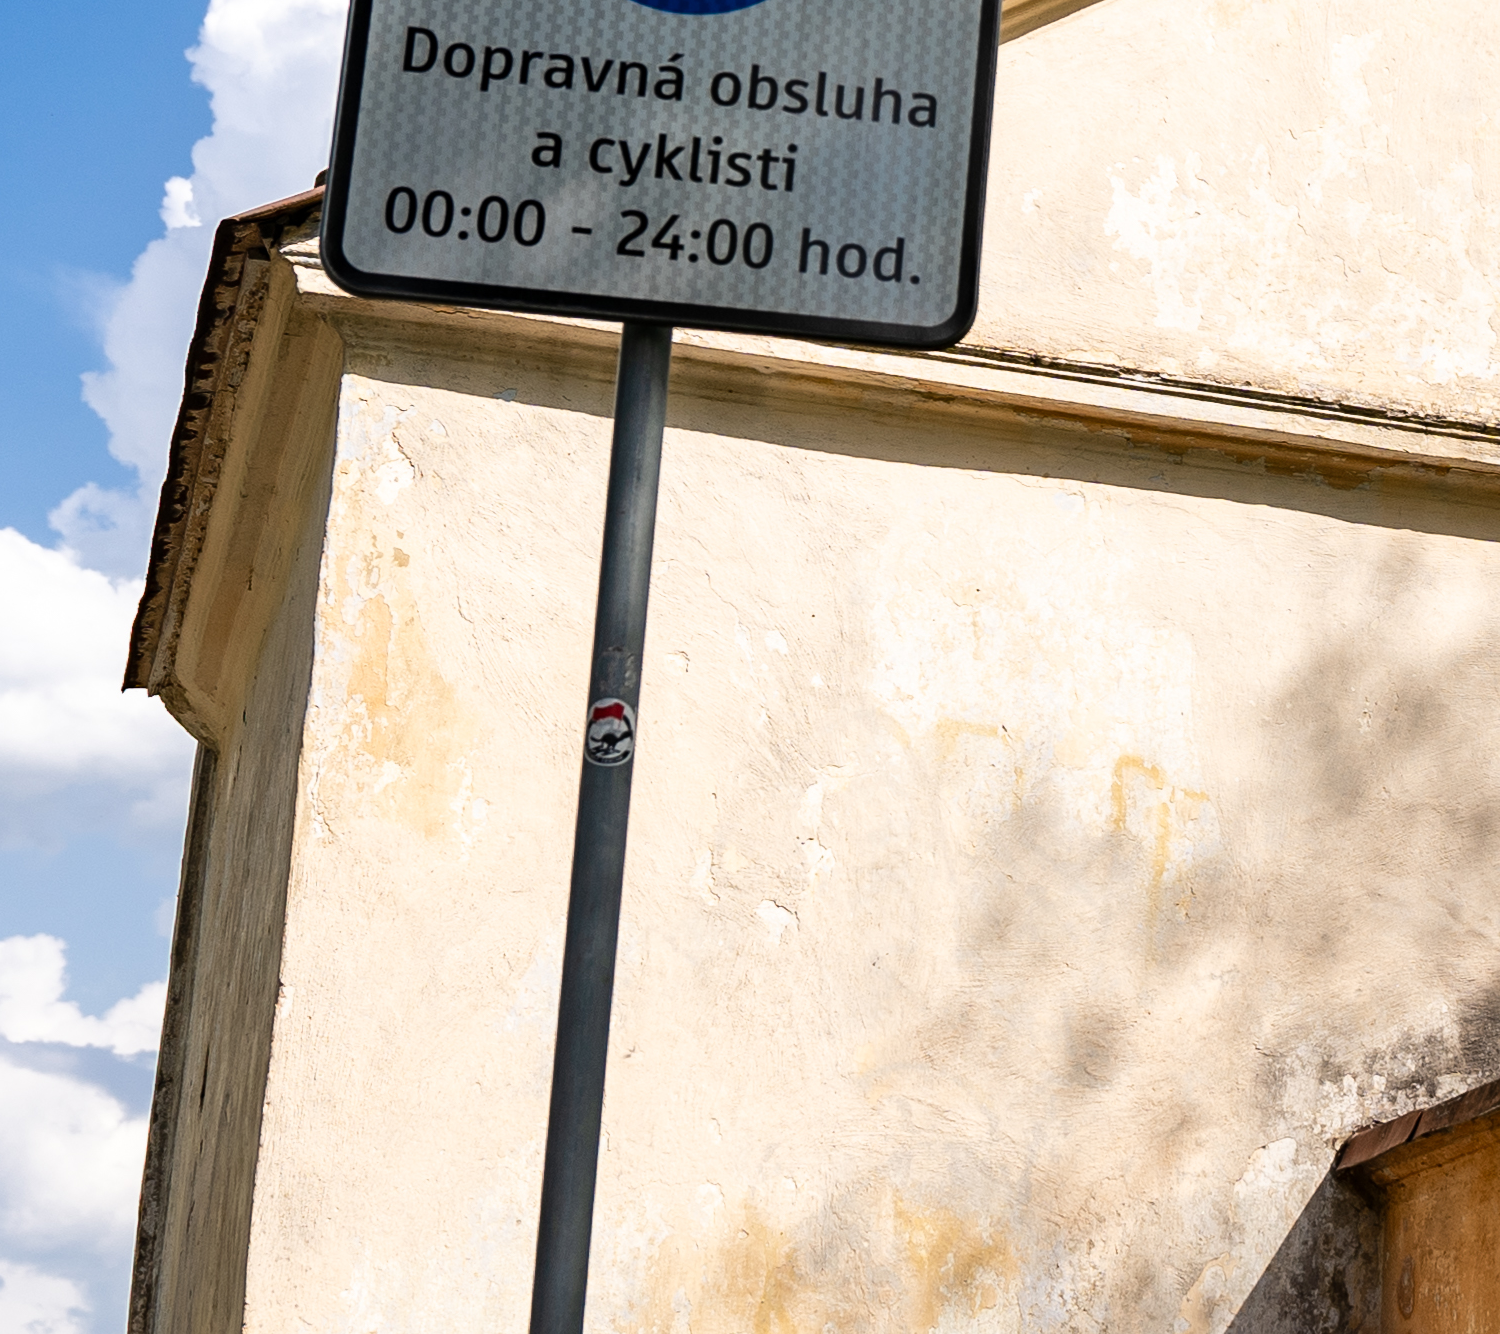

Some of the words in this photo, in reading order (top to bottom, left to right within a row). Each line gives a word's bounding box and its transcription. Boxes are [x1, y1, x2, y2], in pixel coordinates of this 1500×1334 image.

[402, 25, 686, 103] Dopravná
[709, 63, 939, 128] obsluha
[531, 131, 564, 169] a
[588, 132, 799, 193] cyklisti
[384, 185, 546, 248] 00:00
[571, 224, 594, 236] -
[615, 208, 776, 271] 24:00
[798, 226, 922, 286] hod.
